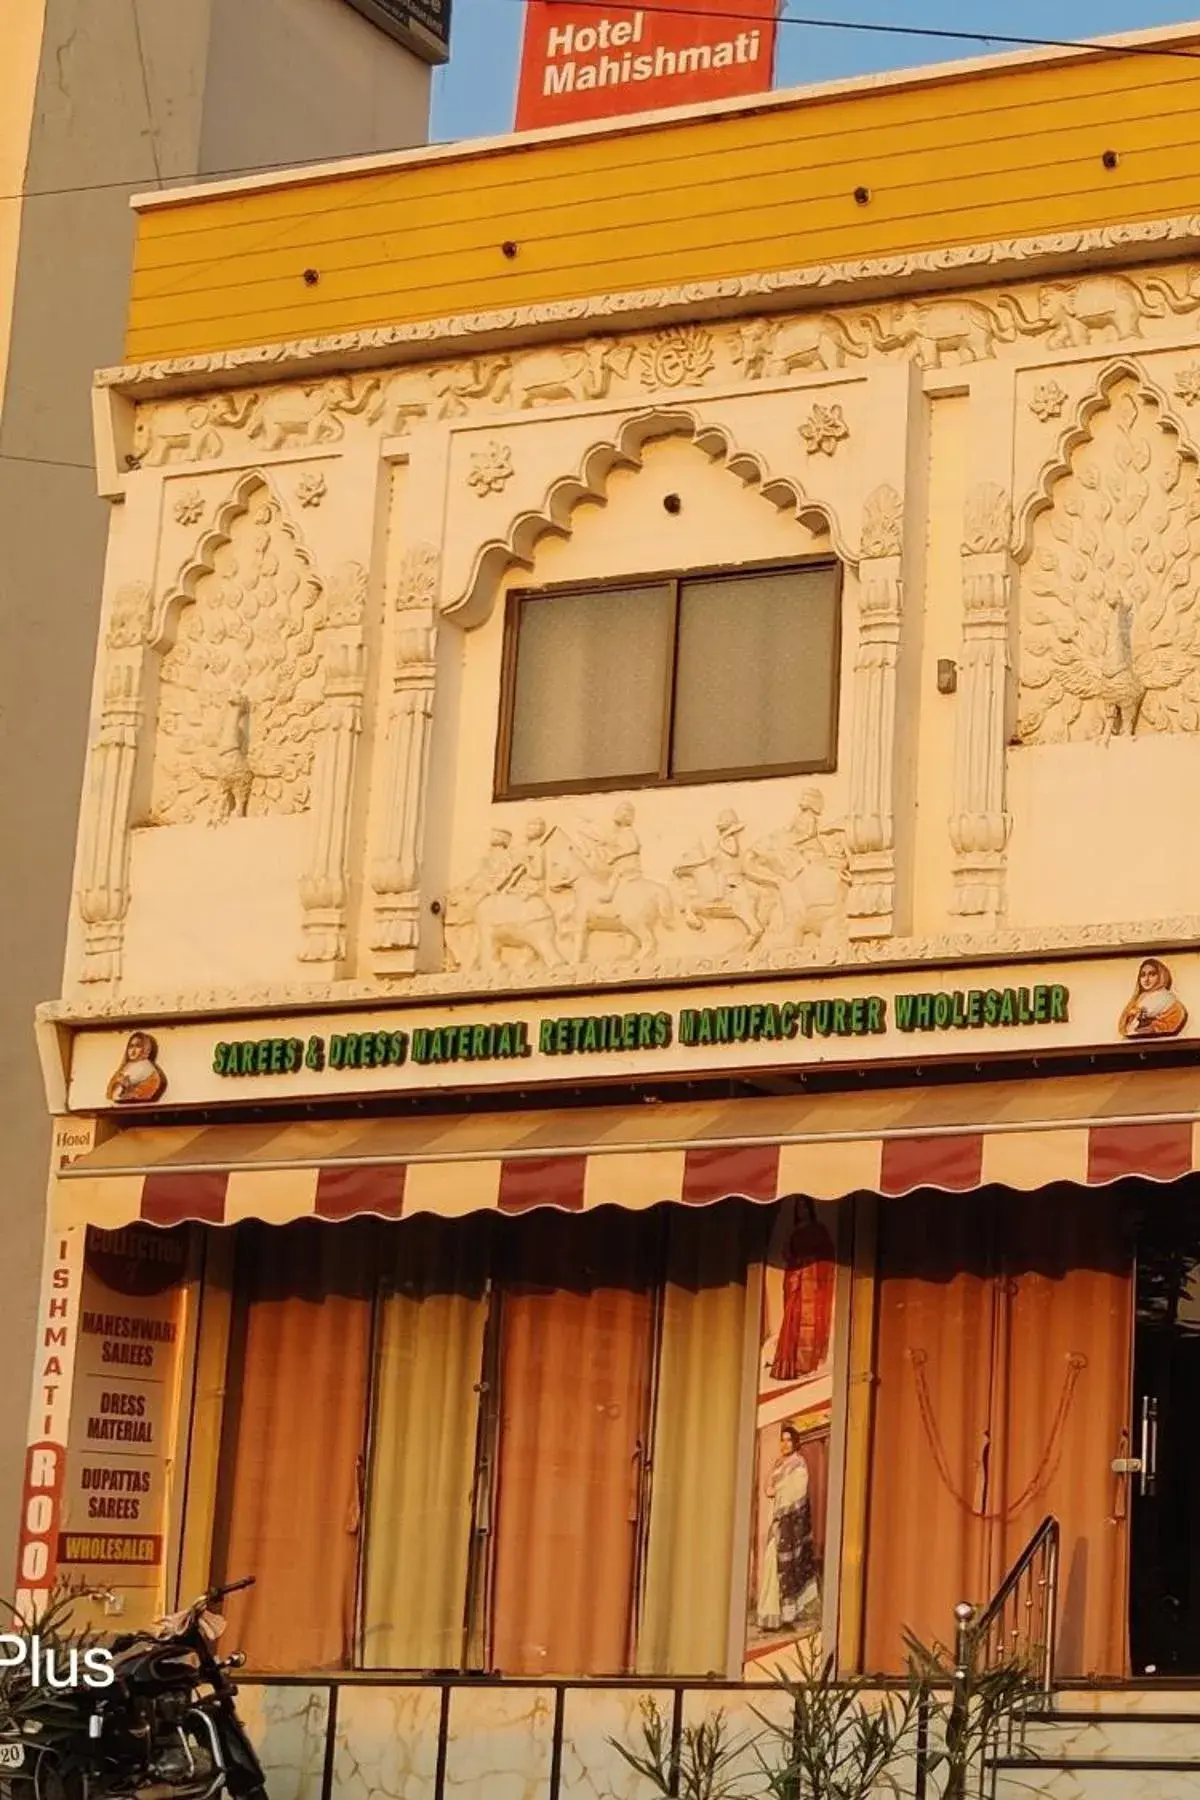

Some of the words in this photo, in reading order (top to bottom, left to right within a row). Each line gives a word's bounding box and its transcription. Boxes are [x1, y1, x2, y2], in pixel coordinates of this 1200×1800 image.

[546, 11, 644, 58] Hotel
[542, 30, 760, 96] Mahishmati
[212, 1037, 303, 1076] SAREES
[305, 1035, 325, 1072] &
[330, 1030, 405, 1069] DRESS
[411, 1022, 531, 1064] MATERIAL
[539, 1013, 672, 1054] RETAILERS
[678, 997, 888, 1045] MANUFACTURER
[895, 984, 1070, 1033] WHOLESALER
[56, 1131, 91, 1148] Hotel
[43, 1155, 75, 1435] ISHMATI
[102, 1341, 154, 1367] SAREES
[100, 1392, 145, 1416] DRESS
[87, 1417, 153, 1443] MATERIAL
[81, 1468, 151, 1491] DUPATTAS
[88, 1496, 140, 1520] SAREES
[65, 1536, 154, 1561] WHOLESALER
